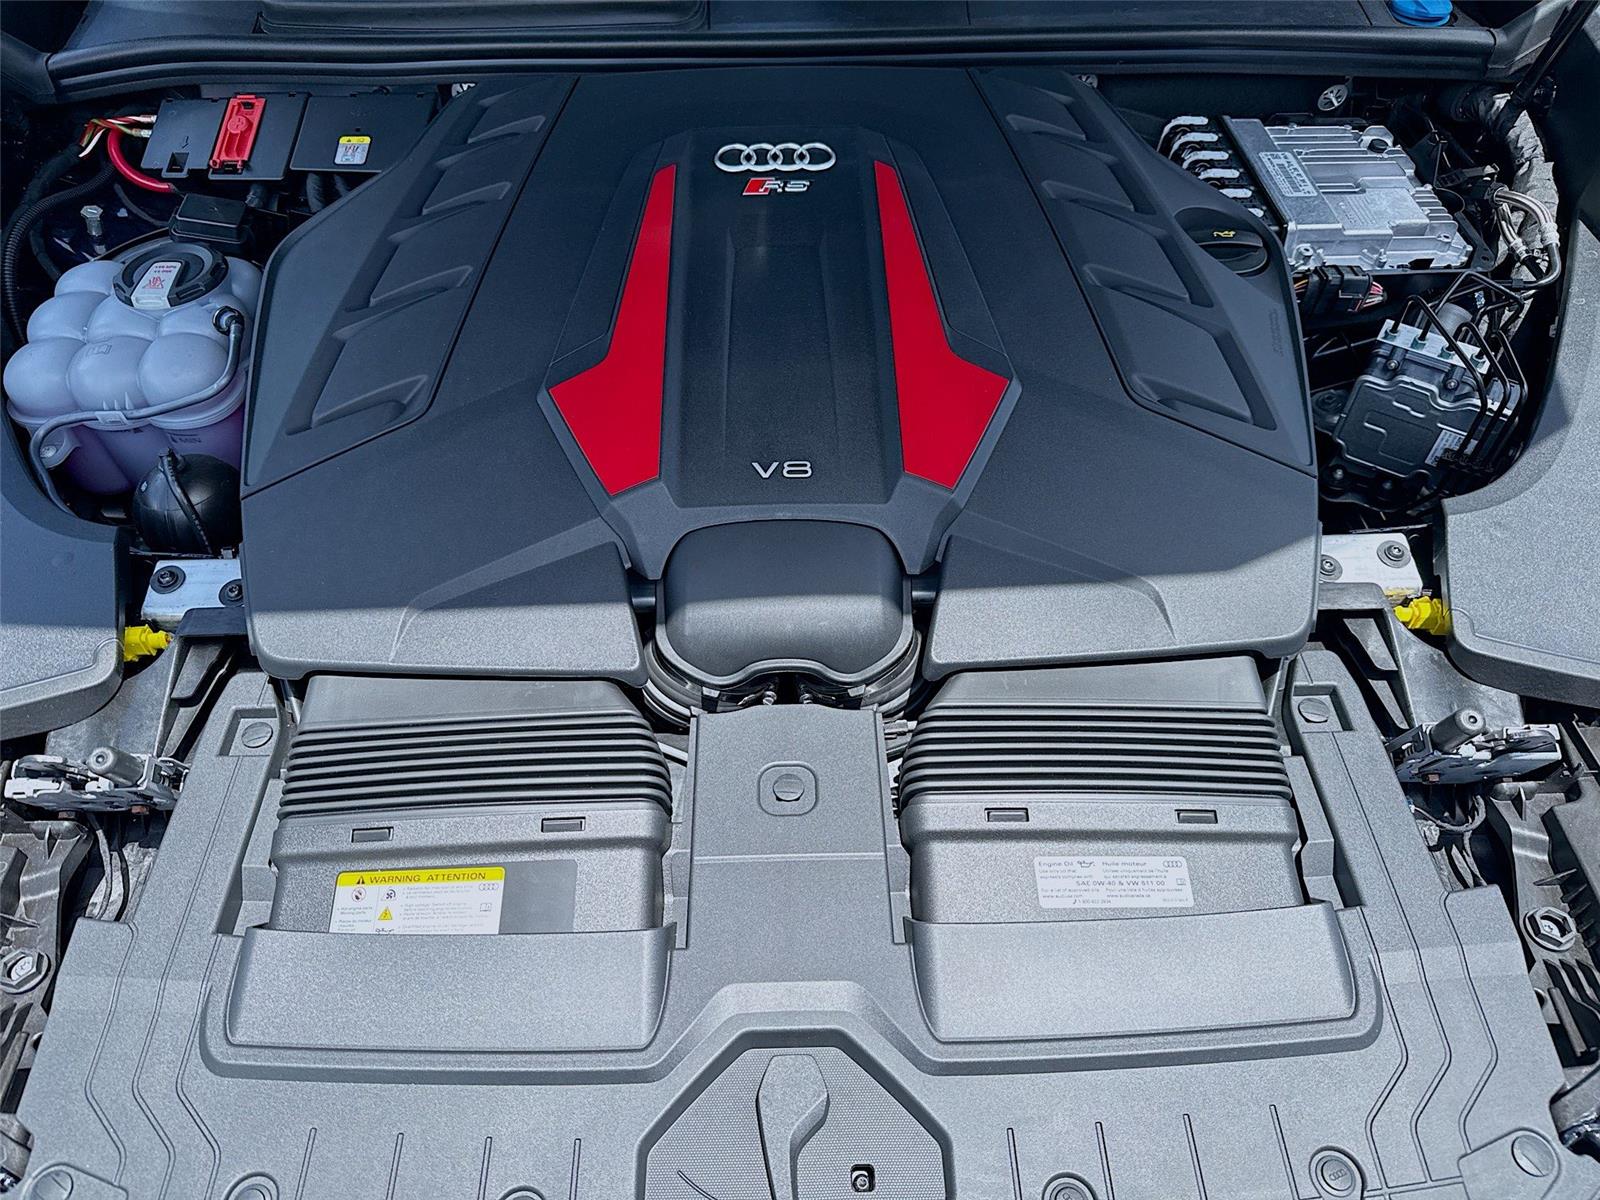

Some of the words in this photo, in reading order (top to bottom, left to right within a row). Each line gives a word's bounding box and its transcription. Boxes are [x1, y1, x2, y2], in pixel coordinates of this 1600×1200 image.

[756, 179, 811, 194] RS
[751, 461, 812, 478] V8
[369, 874, 421, 884] WARNING
[426, 872, 486, 881] ATTENTION
